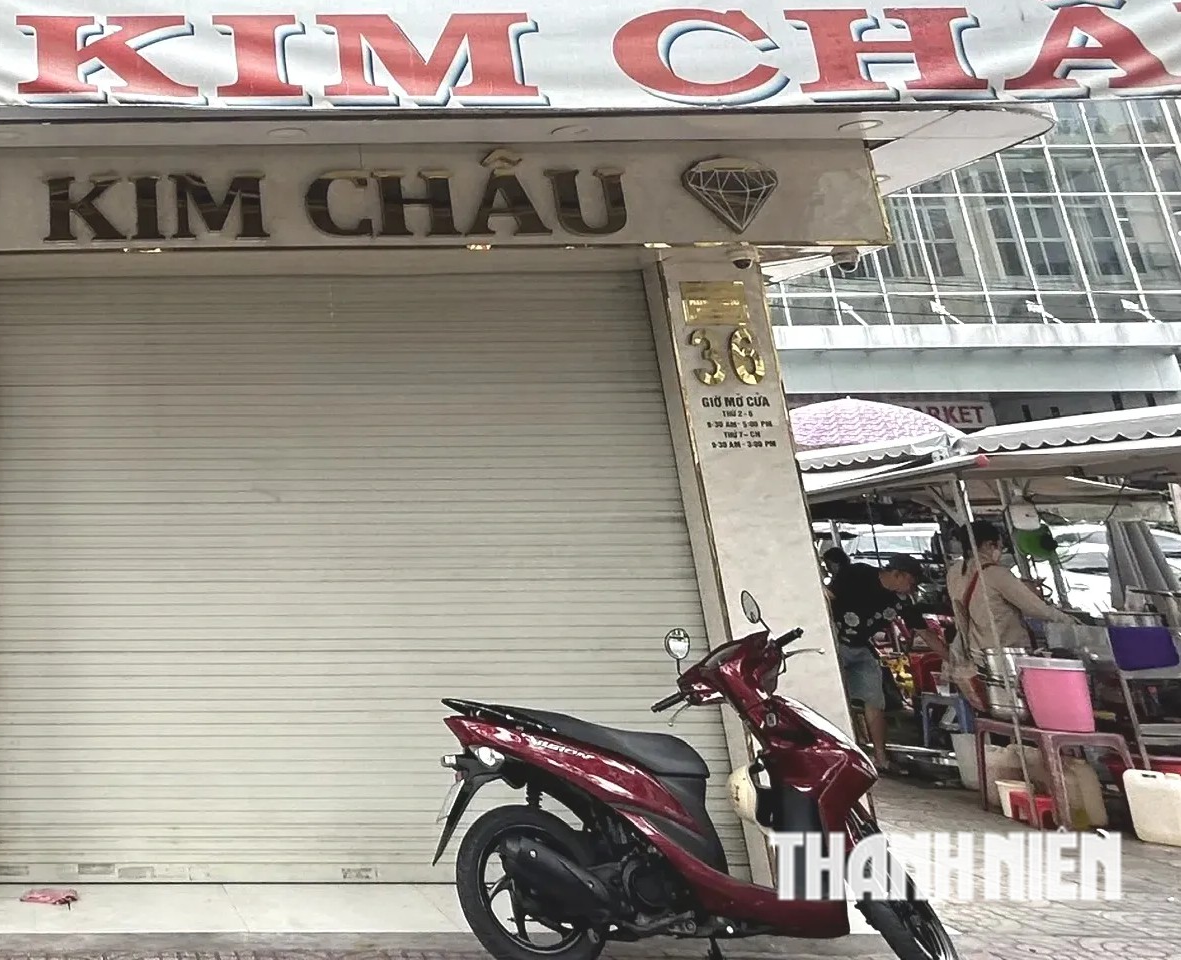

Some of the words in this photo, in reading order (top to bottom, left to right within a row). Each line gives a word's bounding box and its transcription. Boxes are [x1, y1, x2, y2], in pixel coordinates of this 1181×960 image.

[16, 12, 551, 107] KIM
[42, 169, 271, 243] KIM
[304, 147, 628, 238] CHÂU
[689, 327, 767, 386] 36
[701, 394, 722, 408] GIỜ
[724, 392, 744, 407] MỞ
[746, 391, 771, 407] CỬA
[914, 405, 984, 424] RKET
